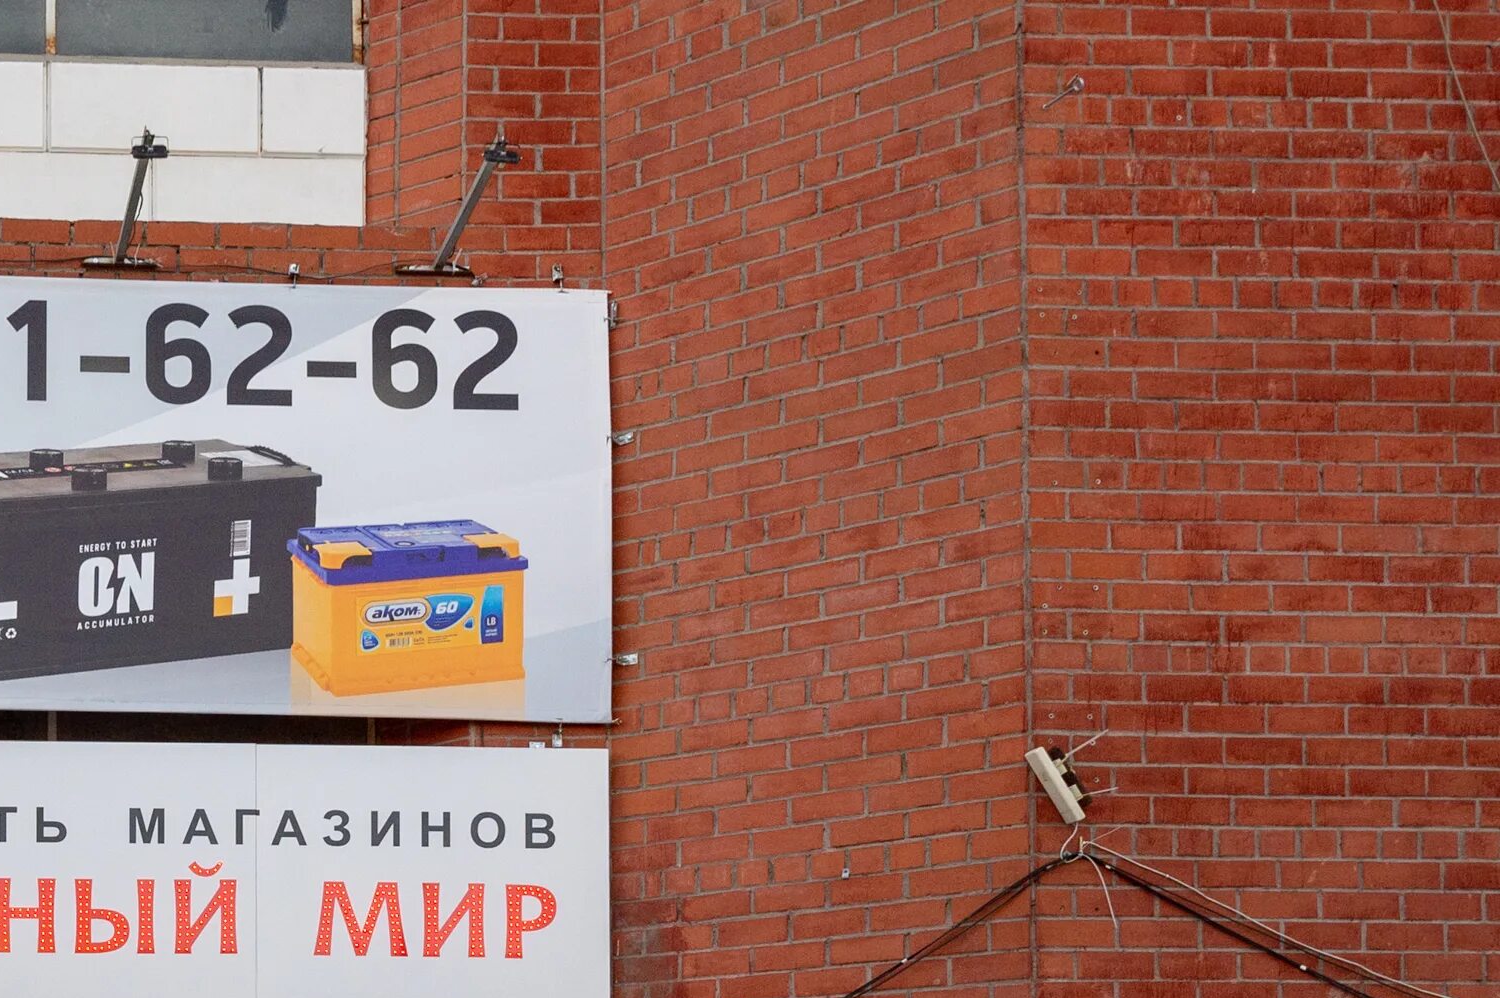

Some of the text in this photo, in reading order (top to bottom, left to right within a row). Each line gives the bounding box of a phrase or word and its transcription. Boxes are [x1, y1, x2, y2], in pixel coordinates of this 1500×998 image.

[79, 538, 158, 553] ENERGY TO START
[78, 551, 155, 617] ON
[77, 614, 155, 631] ACCUMULATOR
[435, 600, 459, 615] 60
[128, 807, 557, 850] МАГАЗИНОВ
[313, 881, 558, 960] МИР
